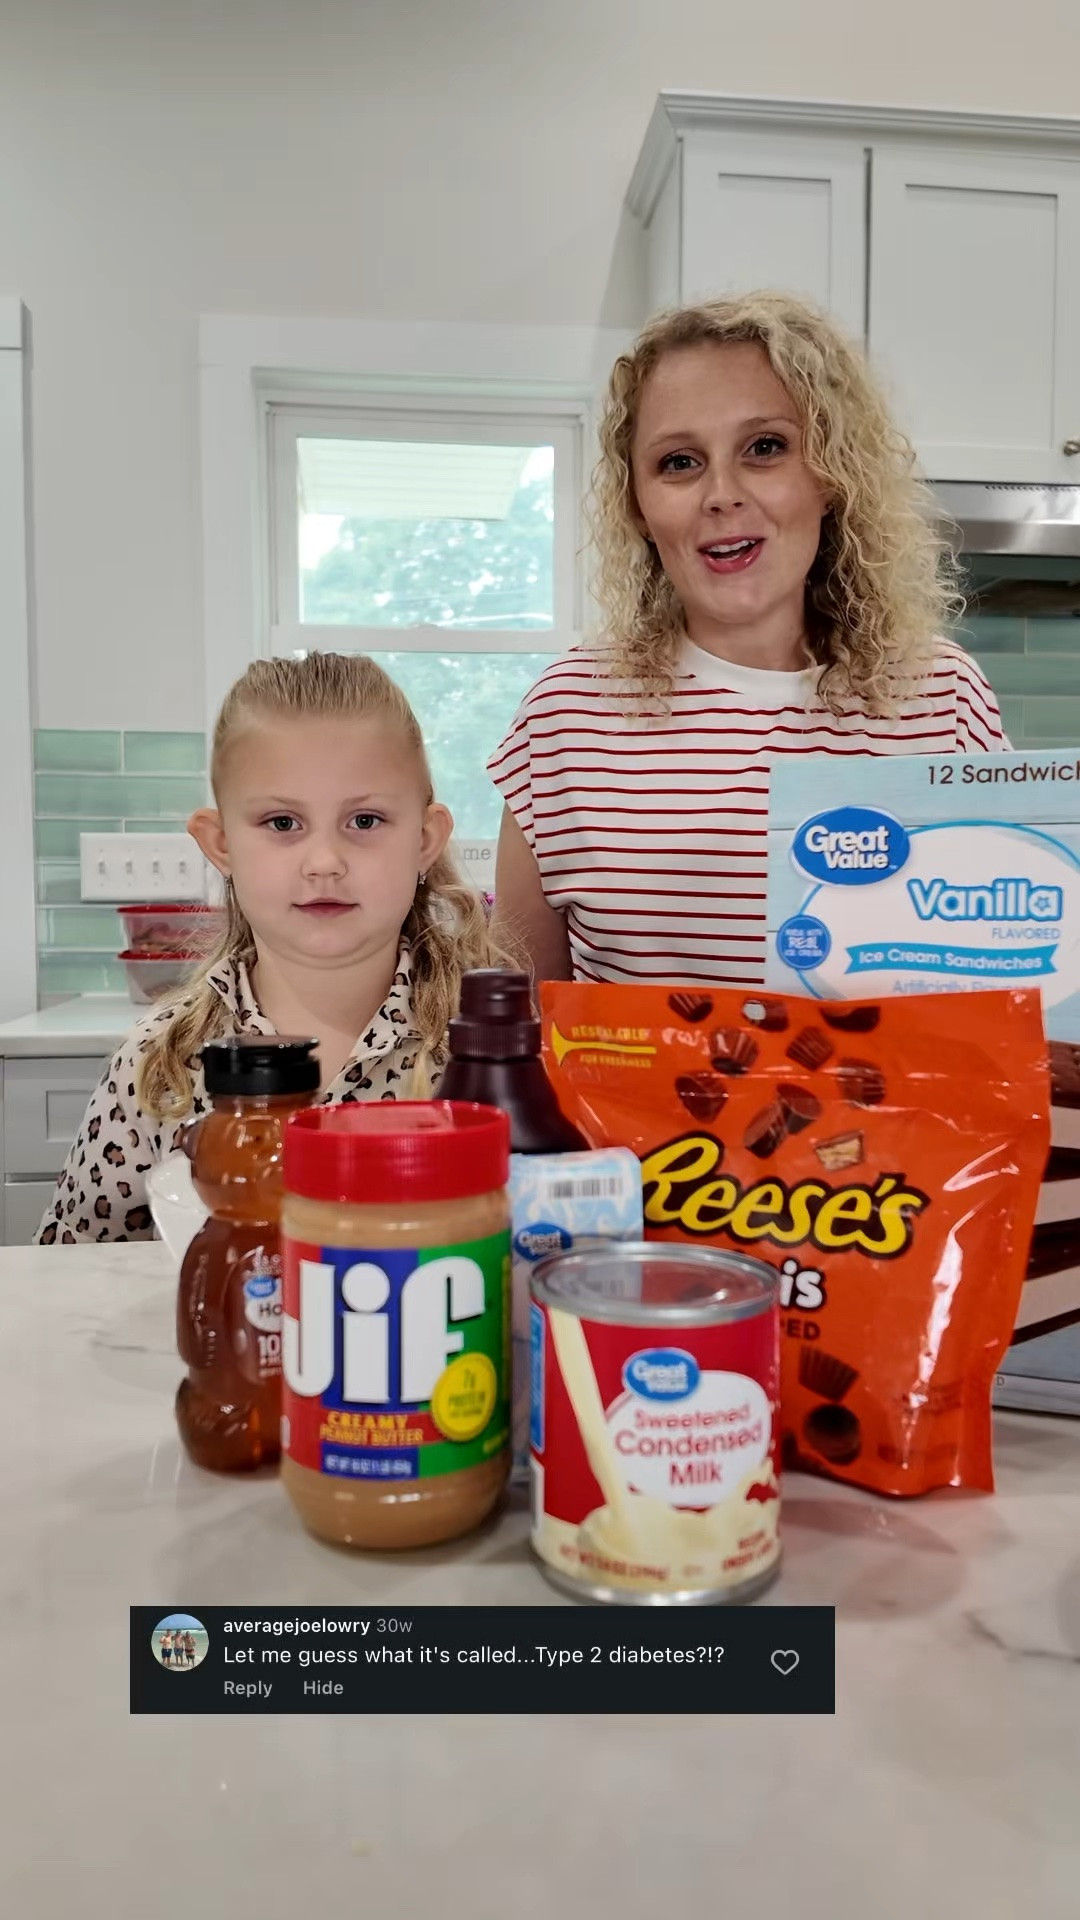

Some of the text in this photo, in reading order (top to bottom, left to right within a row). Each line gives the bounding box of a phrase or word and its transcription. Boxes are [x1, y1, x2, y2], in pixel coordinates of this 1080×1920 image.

[928, 765, 955, 785] 12
[804, 825, 890, 853] Great
[824, 851, 889, 869] Value
[907, 878, 1063, 921] Vanilla
[991, 928, 1060, 940] FLAVORED
[859, 949, 1043, 970] Ice Cream Sandwiches
[641, 1137, 922, 1254] Reese's
[283, 1256, 486, 1404] Jif
[632, 1359, 687, 1382] Great
[328, 1411, 408, 1429] CREAMY
[634, 1401, 751, 1429] Sweetened
[371, 1428, 423, 1446] BUTTER
[615, 1420, 762, 1457] Condensed
[669, 1460, 722, 1486] Milk
